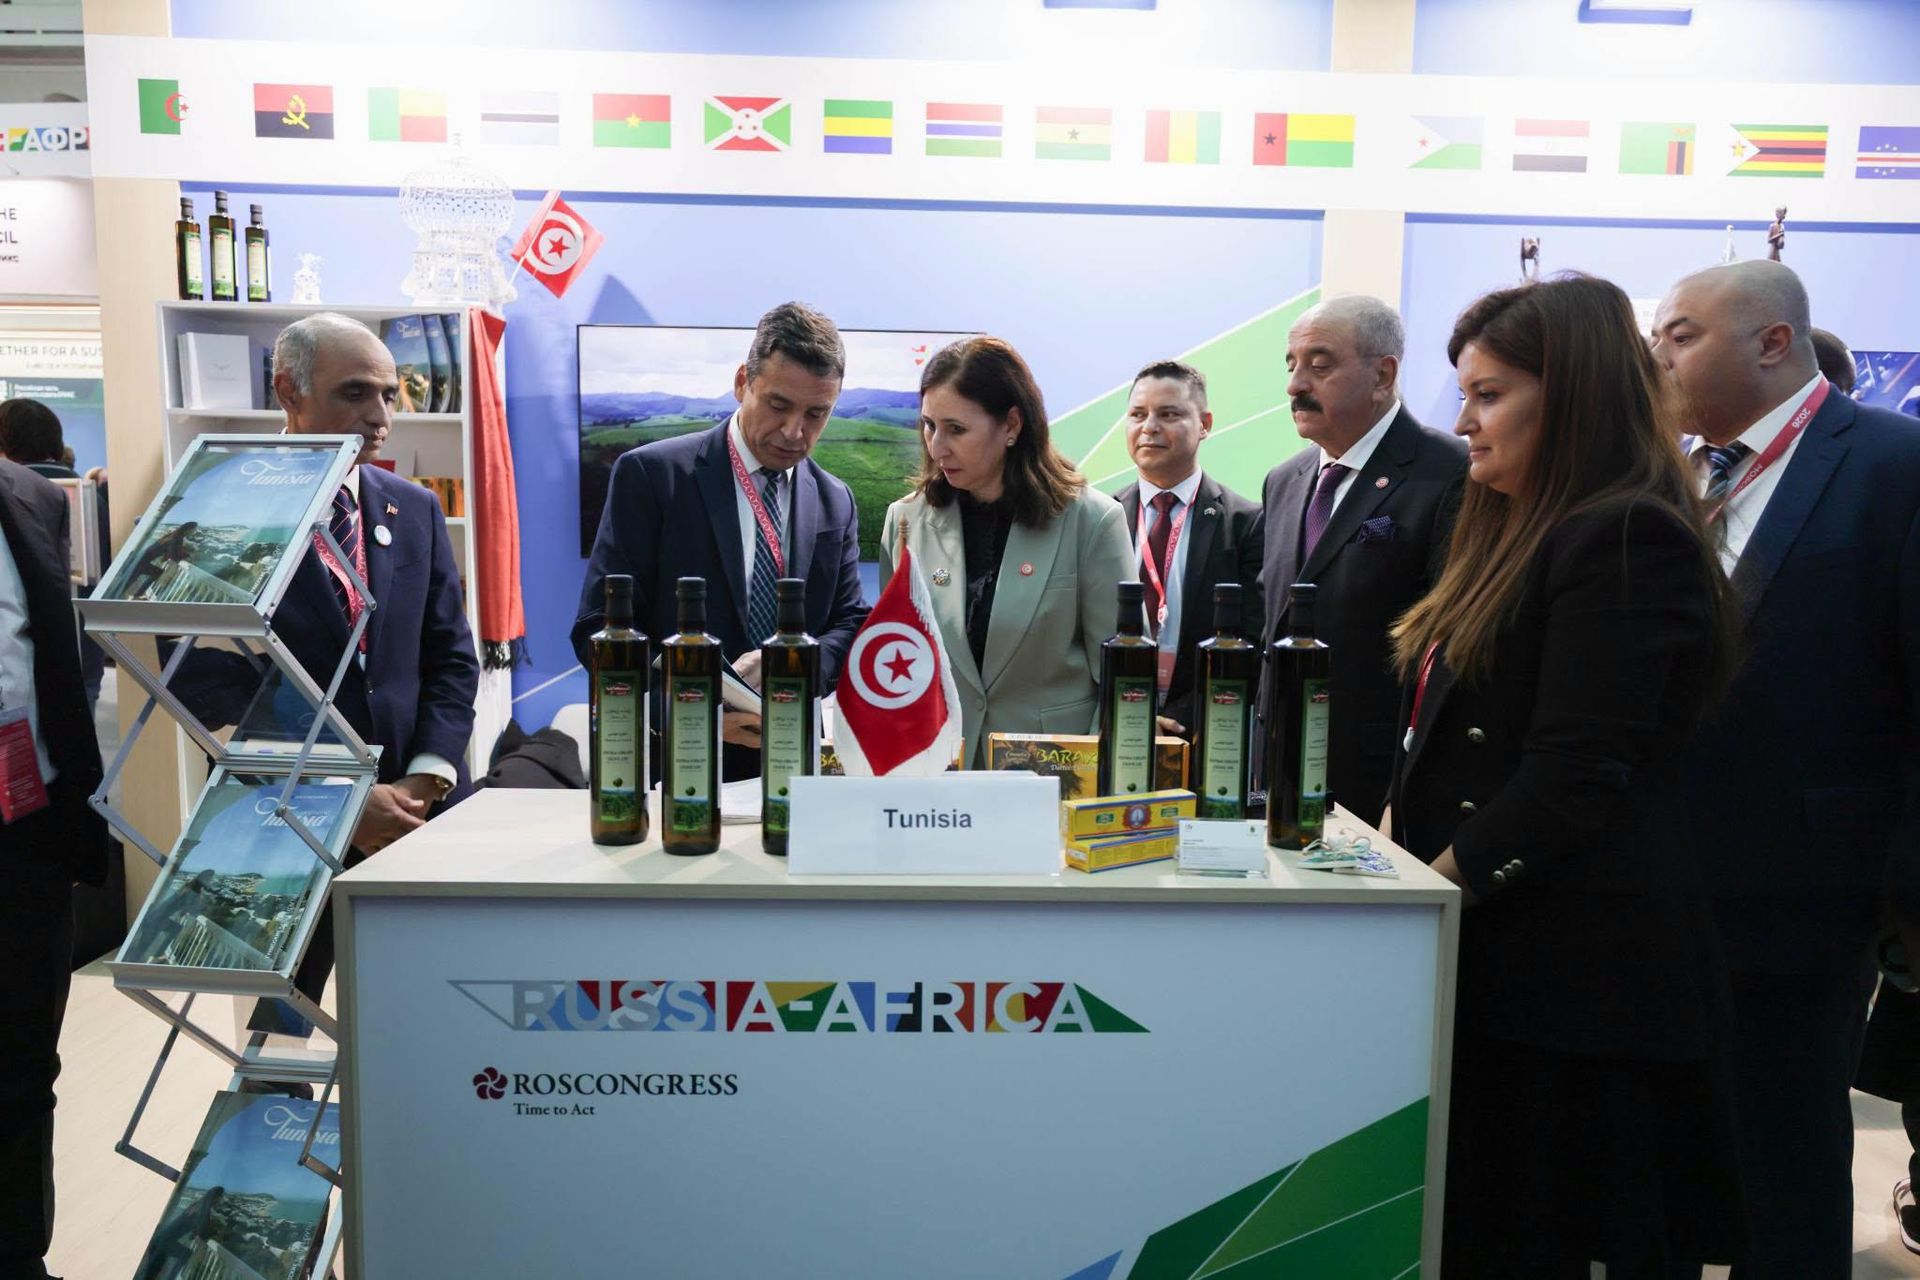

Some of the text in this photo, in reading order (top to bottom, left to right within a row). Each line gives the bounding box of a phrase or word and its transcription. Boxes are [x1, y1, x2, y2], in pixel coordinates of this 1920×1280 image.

[0, 207, 17, 220] HE
[1792, 408, 1810, 428] 2026
[882, 808, 972, 829] Tunisia
[513, 1073, 738, 1096] ROSCONGRESS
[513, 1102, 595, 1116] Time to Act
